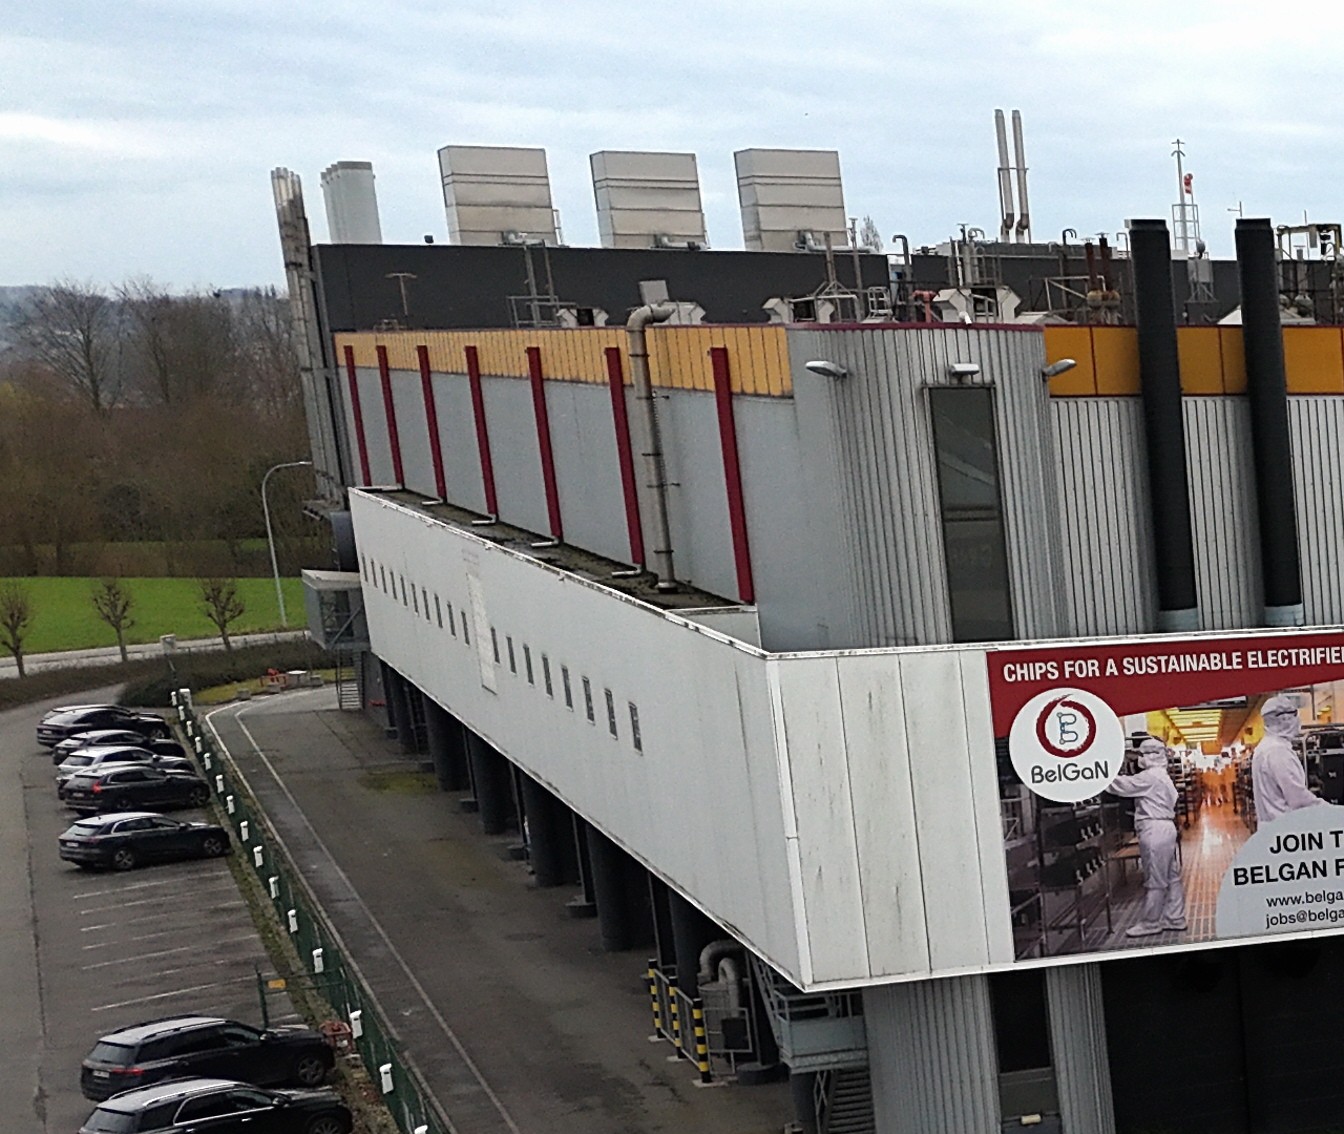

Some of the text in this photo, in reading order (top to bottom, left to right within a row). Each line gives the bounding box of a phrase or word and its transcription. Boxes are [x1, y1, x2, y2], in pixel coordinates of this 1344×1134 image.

[1003, 661, 1059, 682] CHIPS
[1064, 659, 1100, 678] FOR
[1105, 658, 1118, 676] A
[1122, 652, 1243, 675] SUSTAINABLE
[1031, 760, 1109, 784] BelGaN
[1269, 832, 1324, 854] JOIN
[1233, 860, 1327, 886] BELGAN
